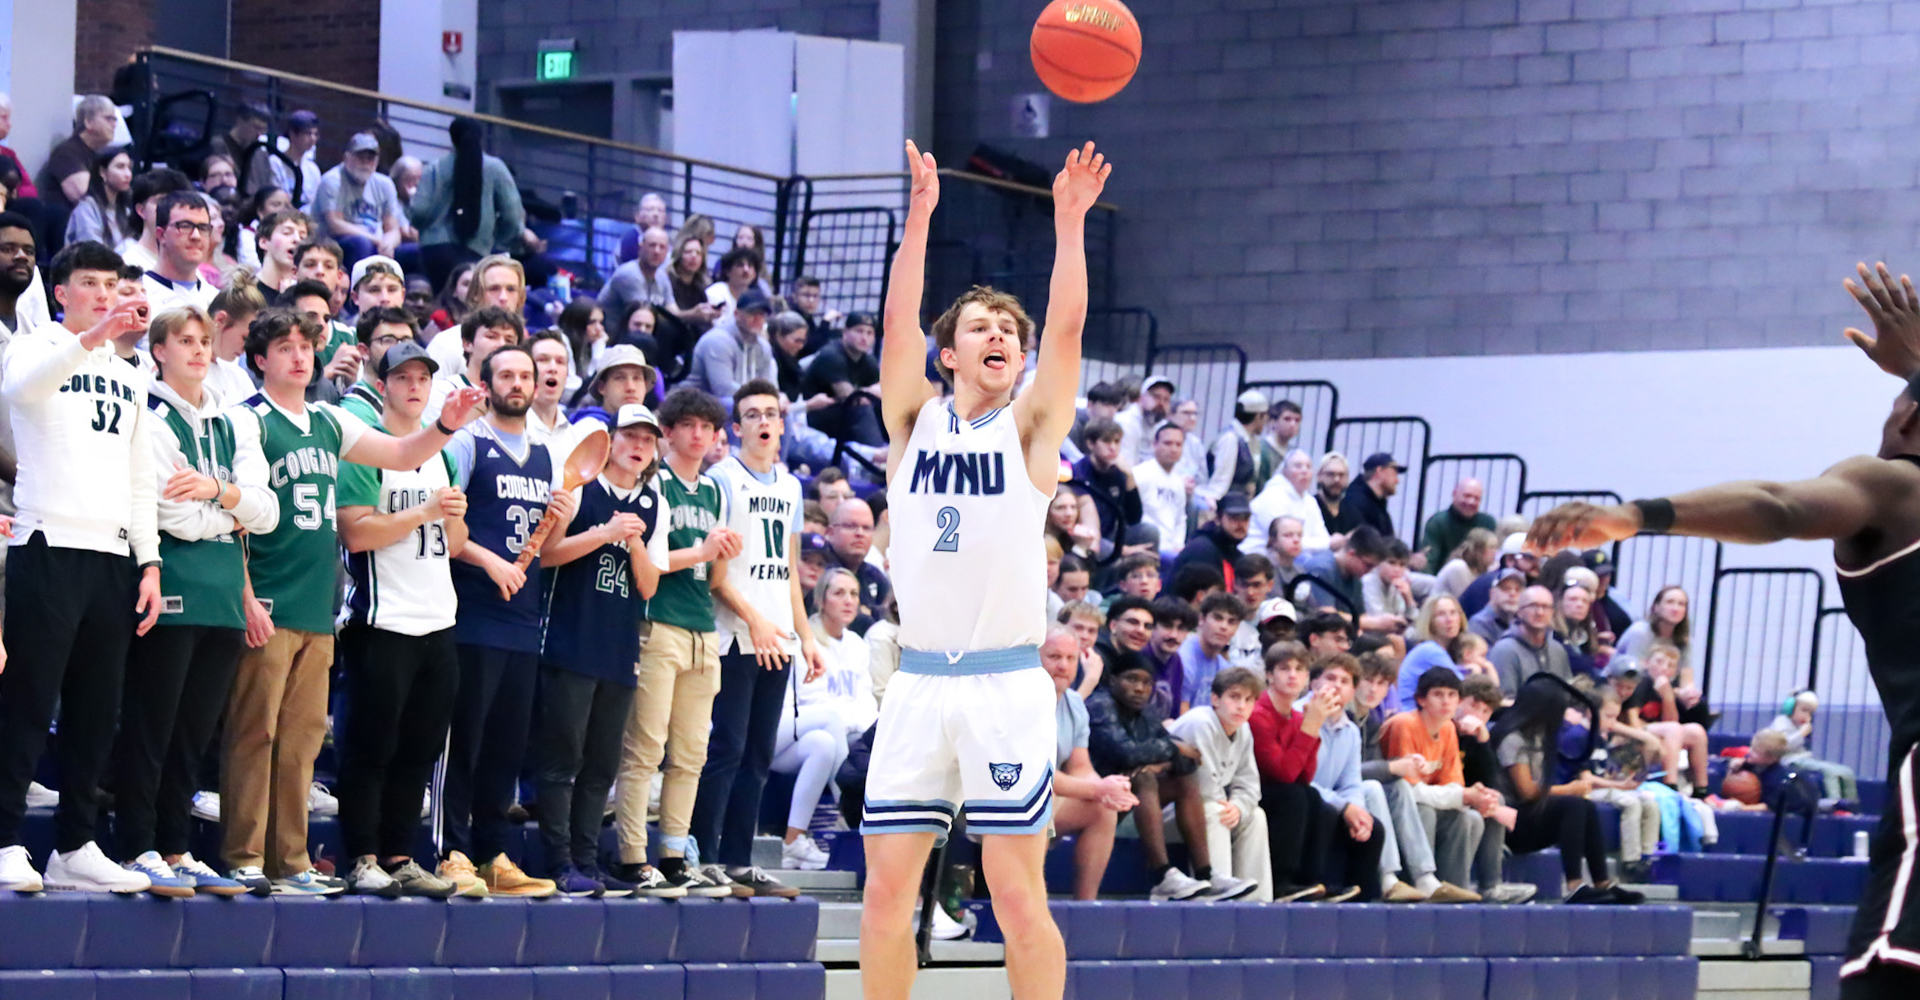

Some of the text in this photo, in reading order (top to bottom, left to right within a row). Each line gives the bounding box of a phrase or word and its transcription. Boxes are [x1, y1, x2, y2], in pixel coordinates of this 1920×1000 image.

[544, 52, 572, 79] EXIT
[496, 474, 550, 504] COUGARS
[909, 449, 1004, 496] MVNU
[293, 483, 338, 532] 54
[749, 496, 792, 516] MOUNT
[415, 520, 448, 560] 13
[760, 518, 785, 559] 10
[932, 506, 961, 552] 2
[595, 553, 630, 598] 24
